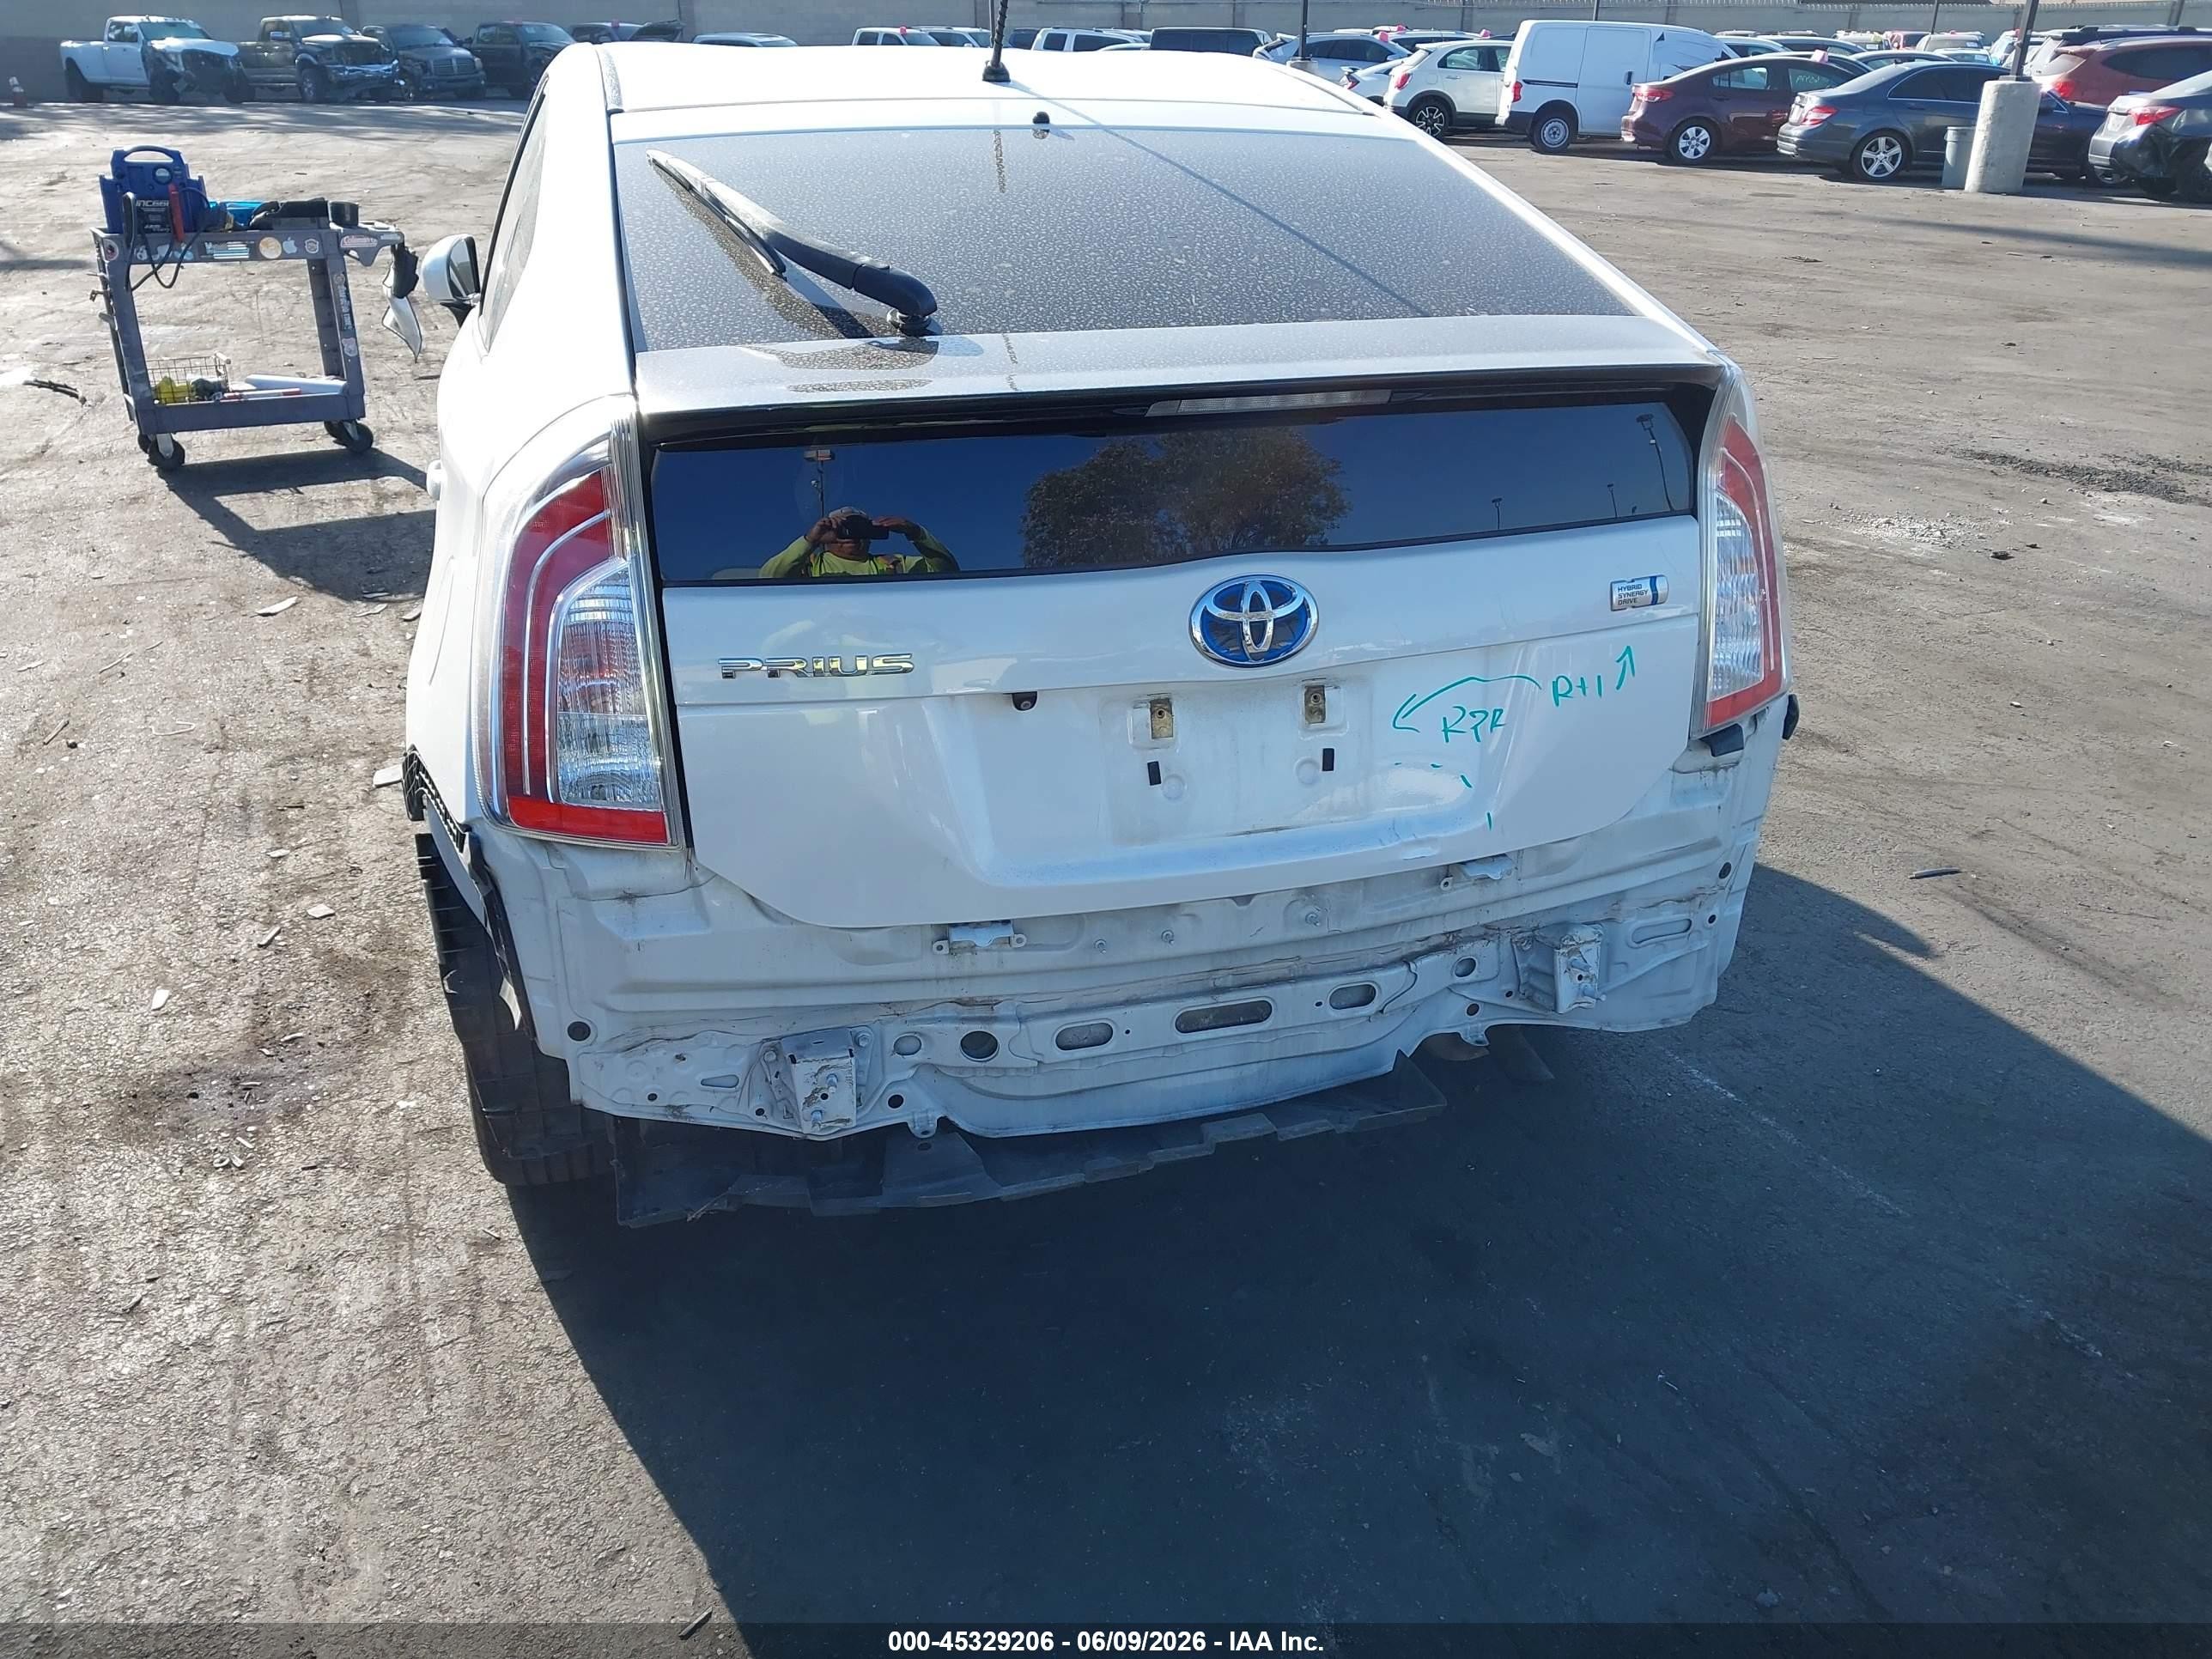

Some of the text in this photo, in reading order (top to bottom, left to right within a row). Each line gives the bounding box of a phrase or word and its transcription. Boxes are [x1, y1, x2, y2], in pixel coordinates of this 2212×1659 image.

[1618, 584, 1643, 592] HYBRID
[1618, 589, 1649, 599] SYNERGY
[1618, 598, 1639, 606] DRIVE
[718, 653, 915, 679] PRIUS
